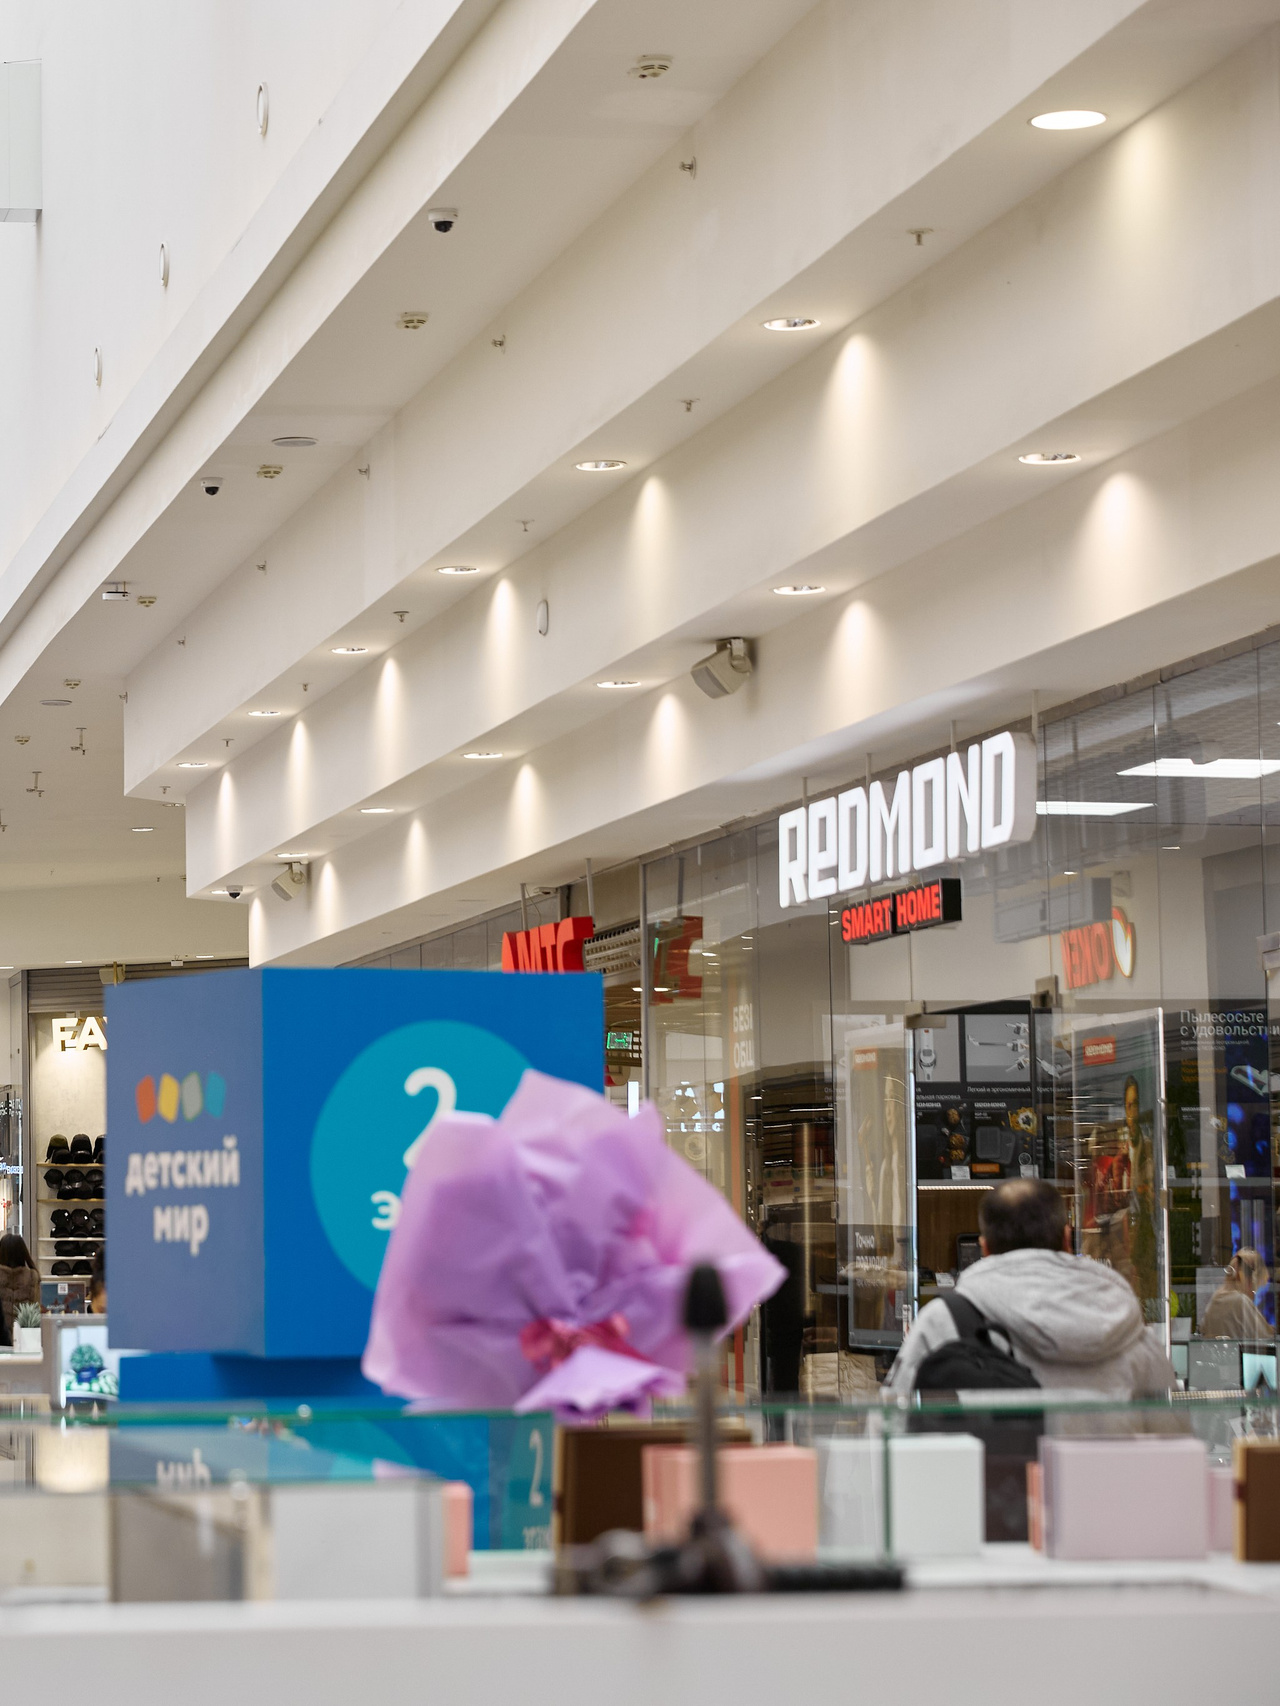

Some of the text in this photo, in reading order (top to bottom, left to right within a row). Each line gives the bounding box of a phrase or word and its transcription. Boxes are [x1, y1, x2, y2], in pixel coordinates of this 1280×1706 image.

[841, 883, 941, 943] SMART HOME
[51, 1016, 108, 1051] FA
[1180, 1010, 1265, 1024] Пылесосьте
[1180, 1026, 1188, 1036] с
[125, 1134, 240, 1196] детский
[153, 1204, 209, 1257] мир
